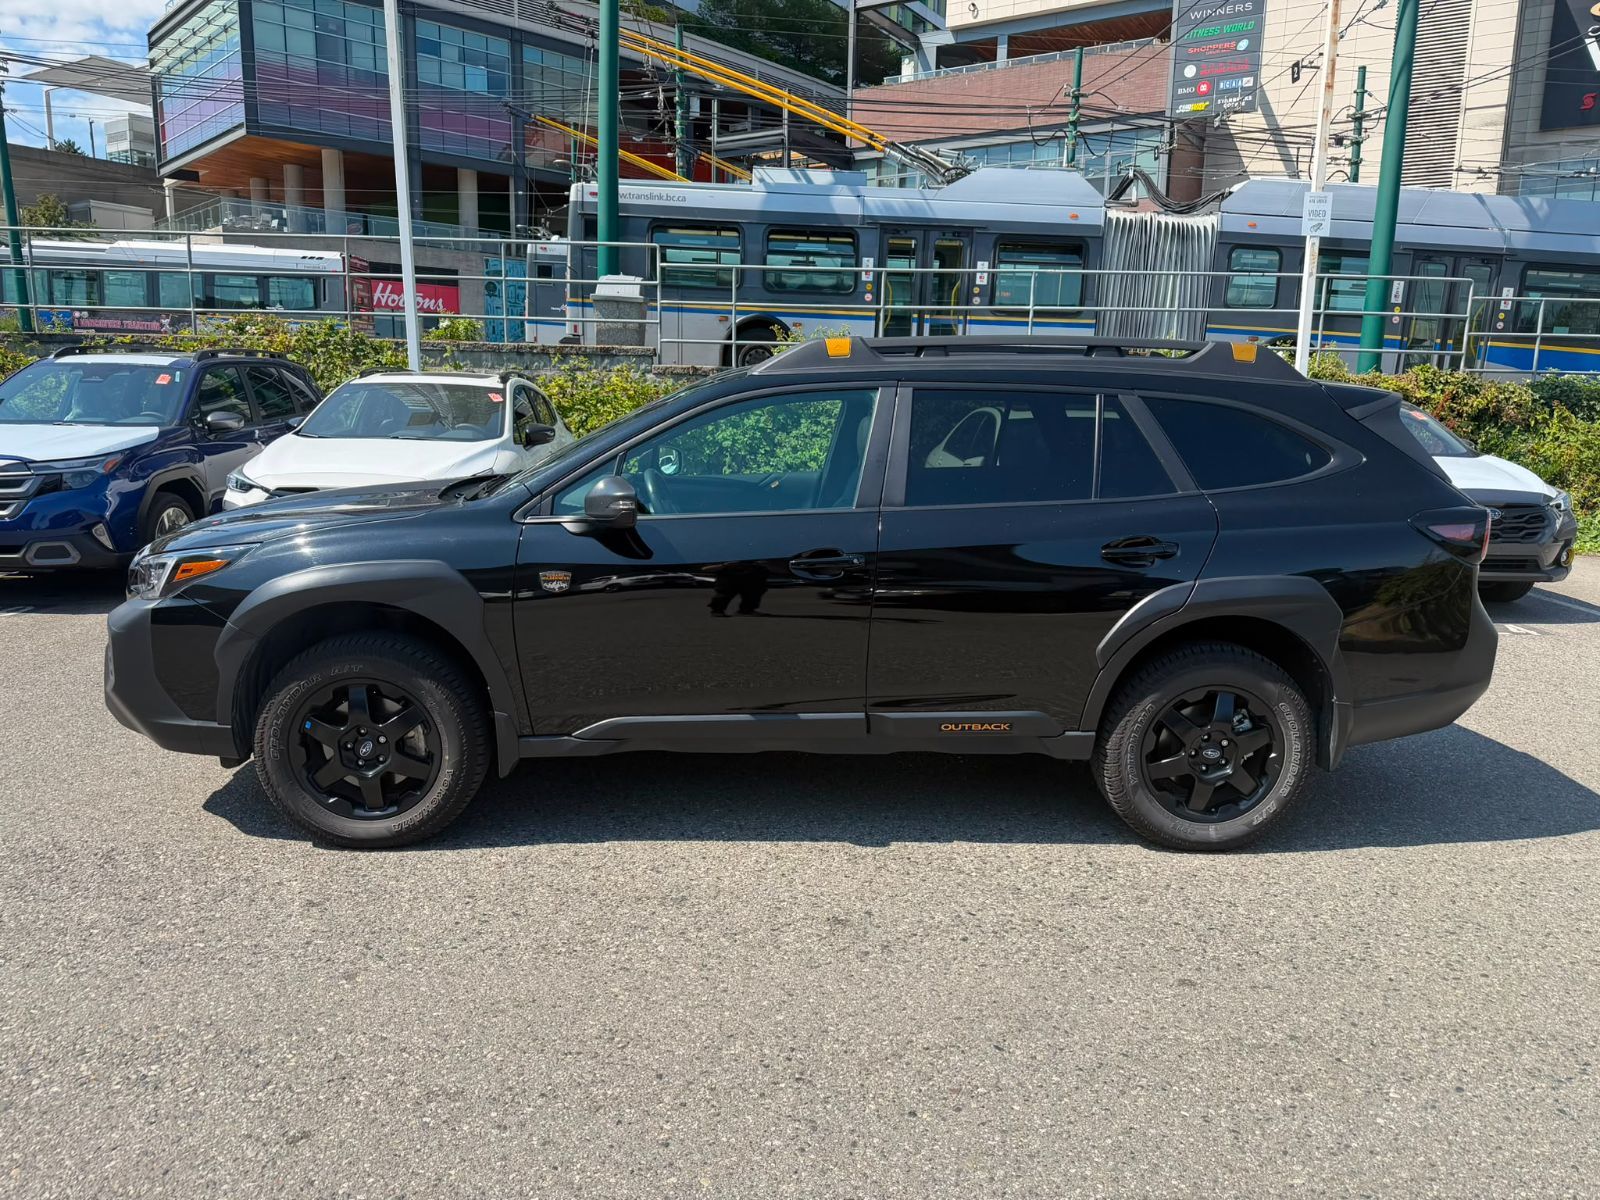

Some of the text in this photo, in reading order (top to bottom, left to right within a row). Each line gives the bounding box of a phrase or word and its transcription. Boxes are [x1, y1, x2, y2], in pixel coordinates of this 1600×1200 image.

[1190, 2, 1253, 20] WINNERS
[1184, 21, 1255, 40] FITNESS WORLD
[1187, 40, 1237, 54] SHOPPERS
[1177, 86, 1195, 95] BMO
[1176, 101, 1210, 114] SUBWAY
[1307, 209, 1327, 218] VIDEO
[373, 281, 445, 313] Hoons
[940, 722, 1010, 731] OUTBACK
[1279, 702, 1301, 797] GEOLANDAR
